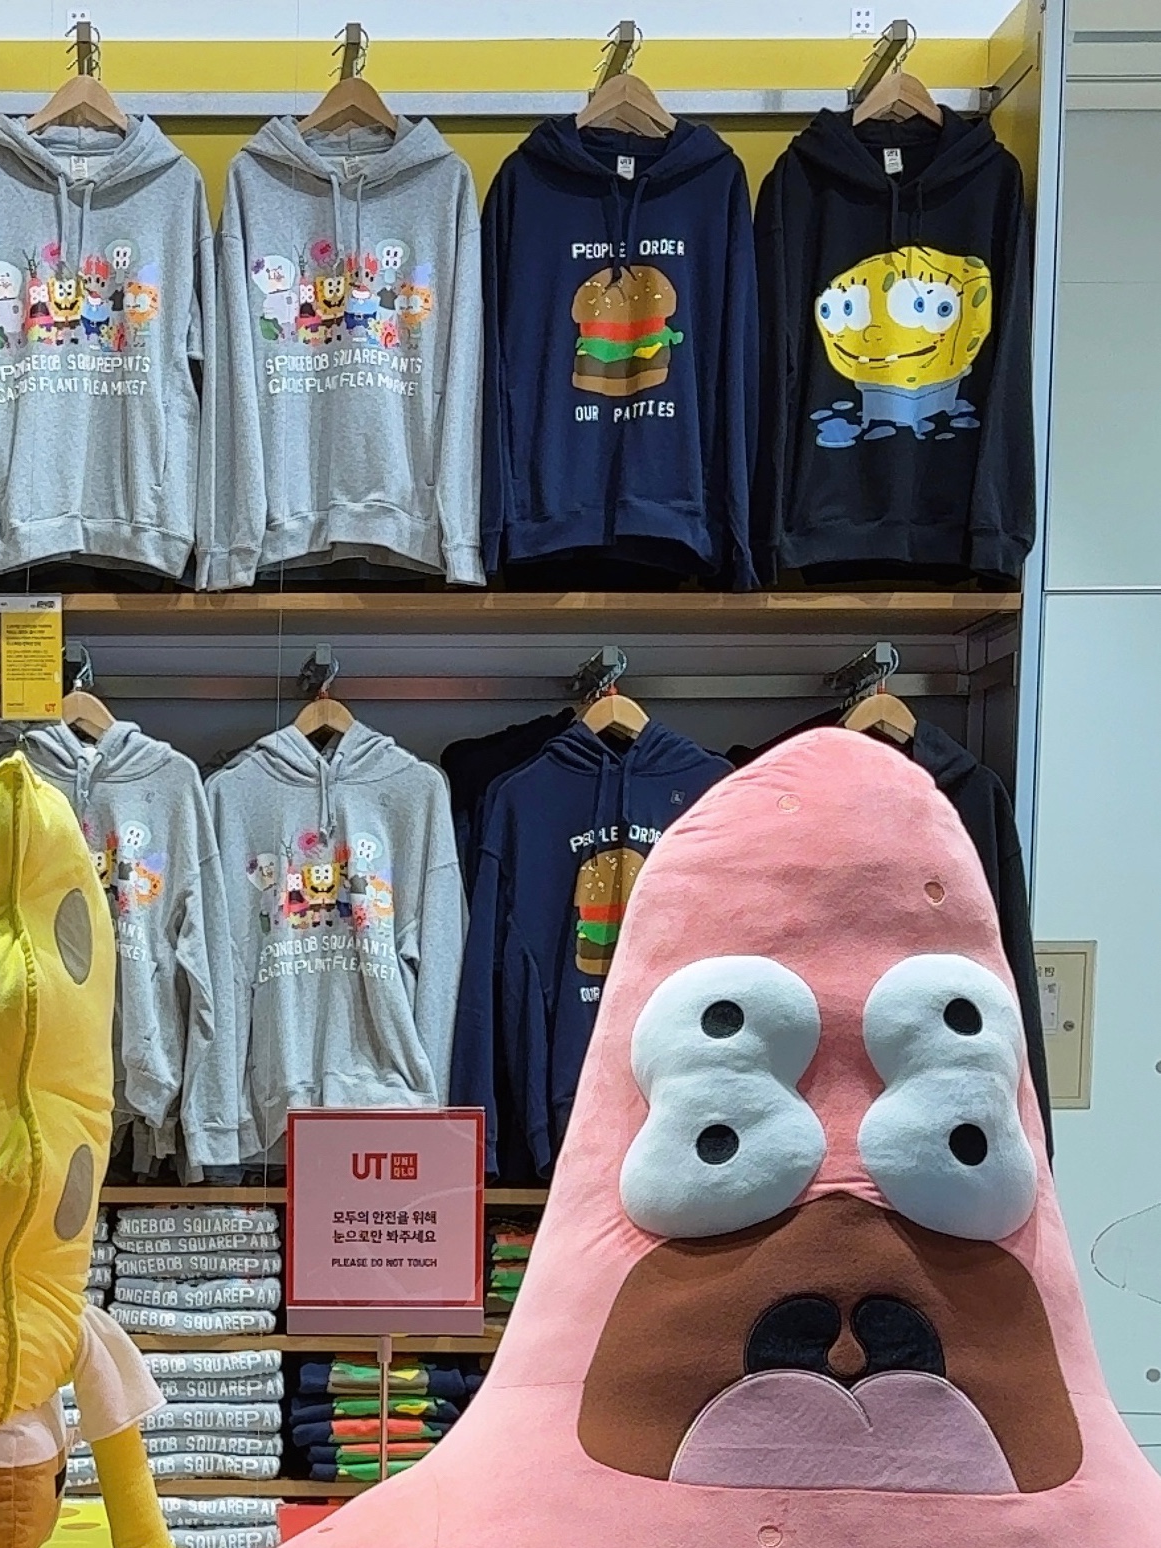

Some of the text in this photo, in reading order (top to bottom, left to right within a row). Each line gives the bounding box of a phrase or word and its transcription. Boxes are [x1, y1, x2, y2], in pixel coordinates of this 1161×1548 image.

[639, 239, 685, 256] ORDER
[340, 371, 374, 388] FLEA
[575, 400, 675, 423] OUR PATTIES
[352, 1153, 388, 1180] UT
[393, 1157, 415, 1167] UNI
[393, 1167, 415, 1178] QLO
[333, 1211, 437, 1225] 모두의 안전을 위해
[333, 1230, 436, 1244] 눈으로만 봐주세요
[332, 1258, 437, 1268] PLEASE DO NOT TOUCH
